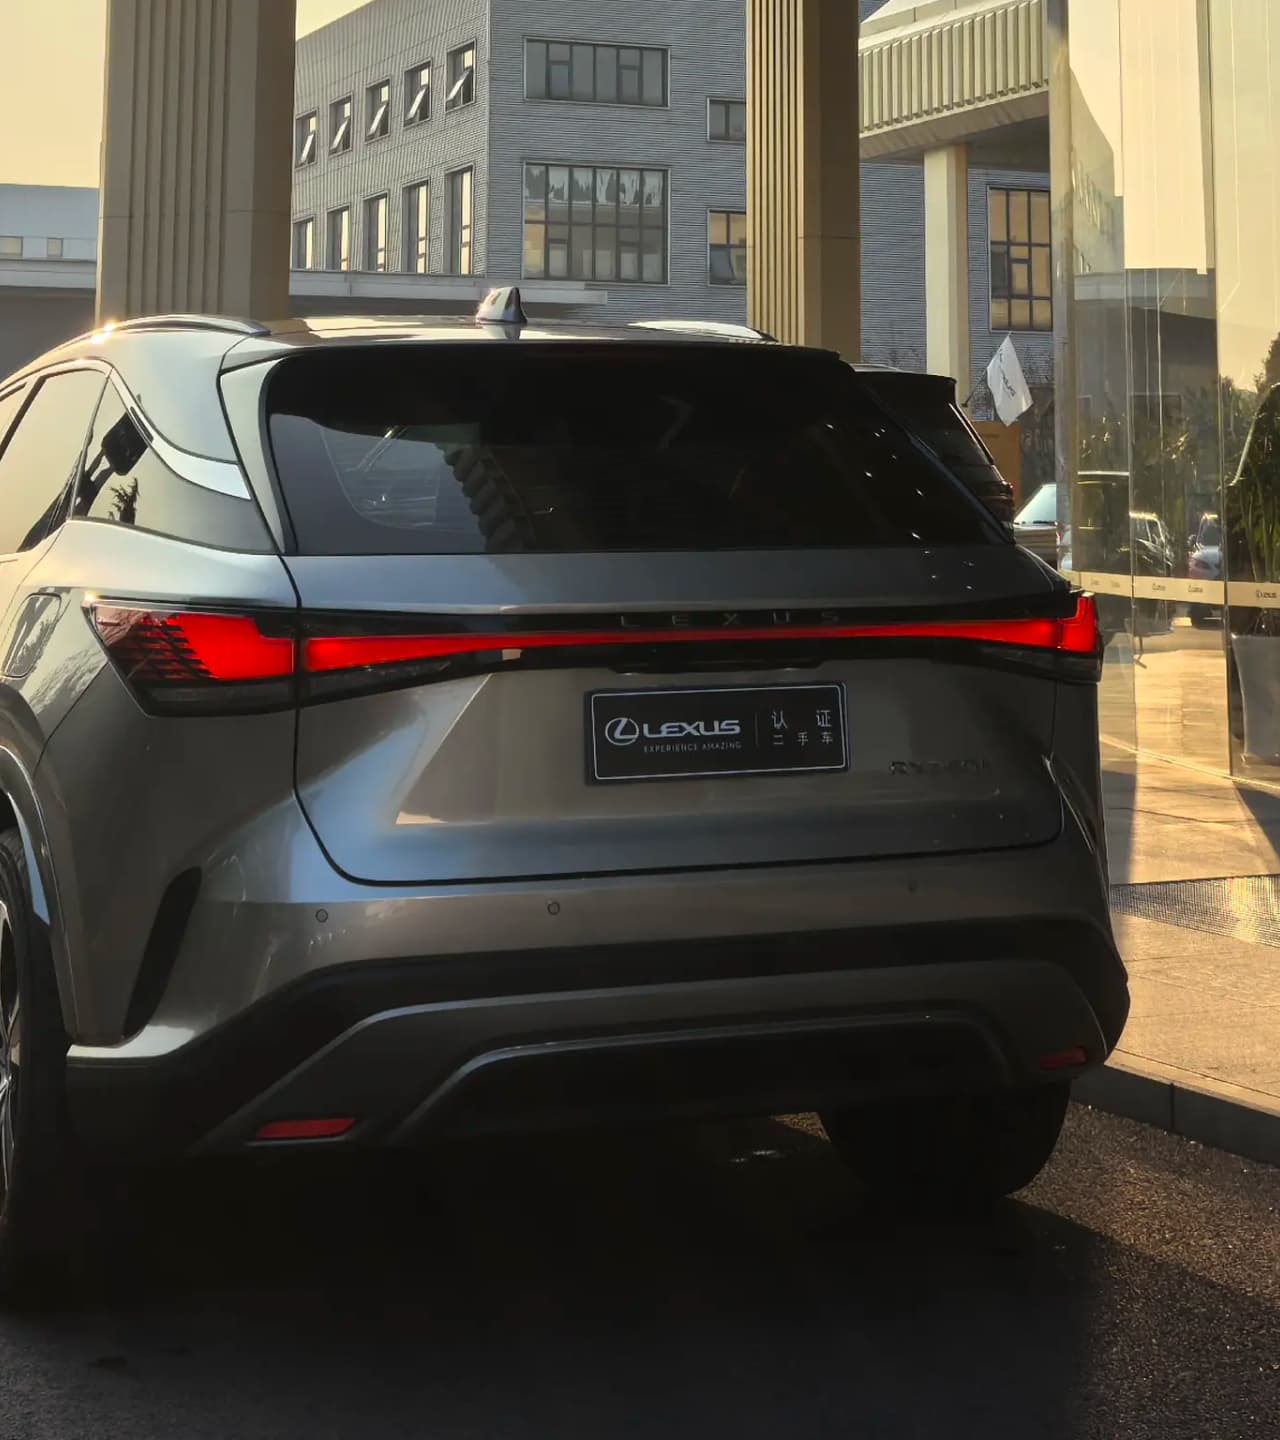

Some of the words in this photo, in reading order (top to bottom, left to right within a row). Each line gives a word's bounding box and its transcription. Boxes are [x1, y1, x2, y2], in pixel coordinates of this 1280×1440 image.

[619, 610, 839, 628] LEXUS
[642, 718, 741, 739] LEXUS
[771, 709, 832, 730] 认证
[643, 743, 698, 754] EXPERIENCE
[701, 740, 742, 752] AMAZING
[773, 732, 833, 746] 二手车
